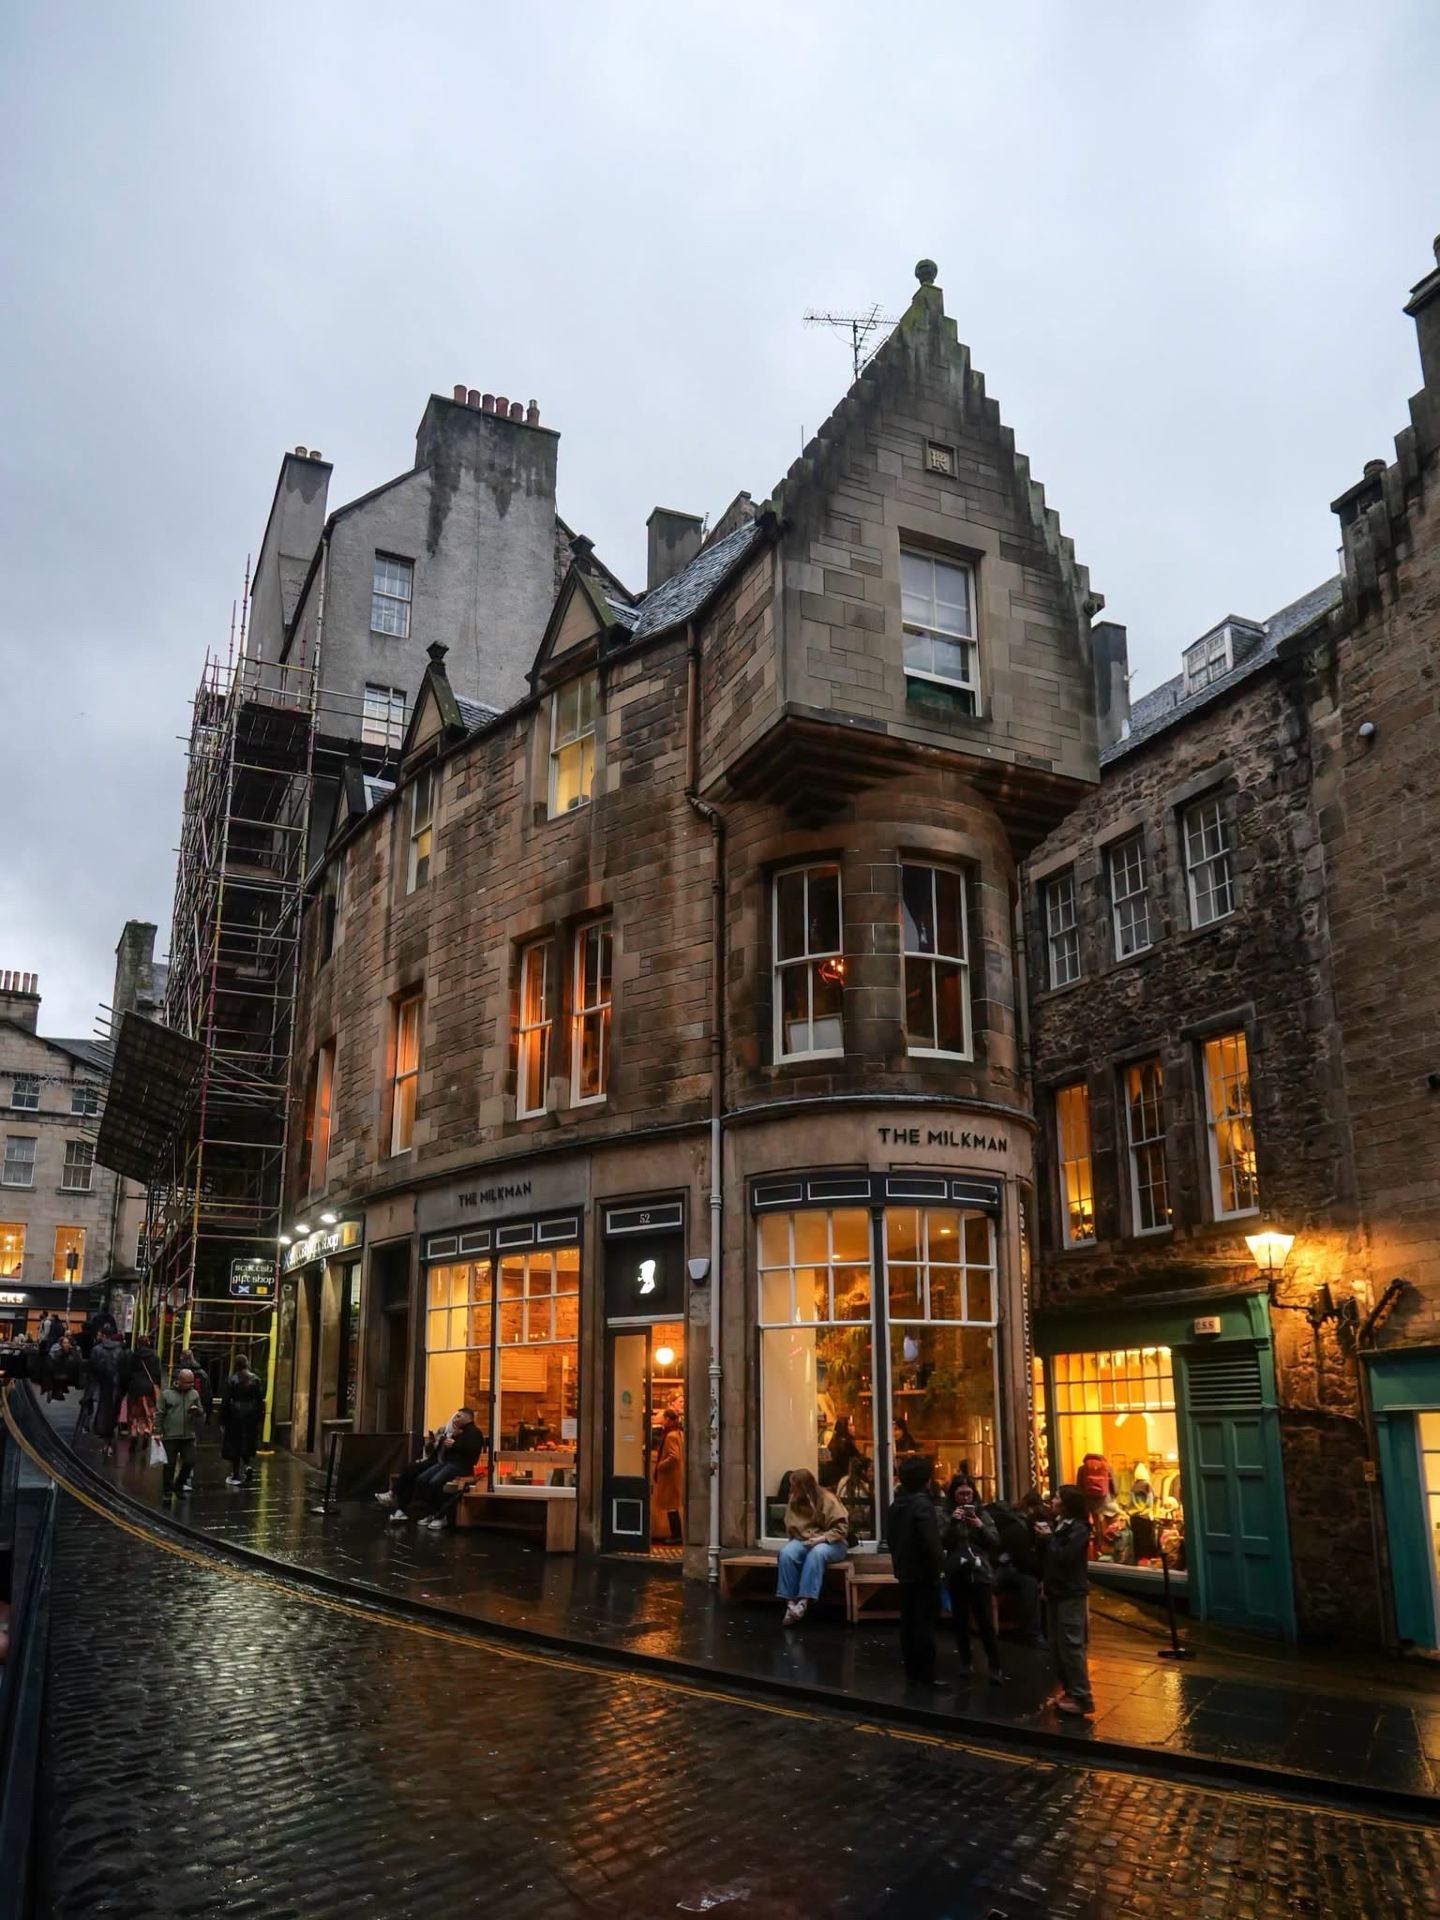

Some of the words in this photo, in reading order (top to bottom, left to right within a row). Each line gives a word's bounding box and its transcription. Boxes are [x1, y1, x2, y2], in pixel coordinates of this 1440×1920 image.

[878, 1128, 919, 1144] THE
[928, 1130, 1007, 1152] MILKMAN
[458, 1192, 477, 1208] THE
[480, 1181, 532, 1203] MILKMAN
[639, 1213, 651, 1224] 52
[232, 1273, 251, 1284] gift
[252, 1274, 275, 1285] shop
